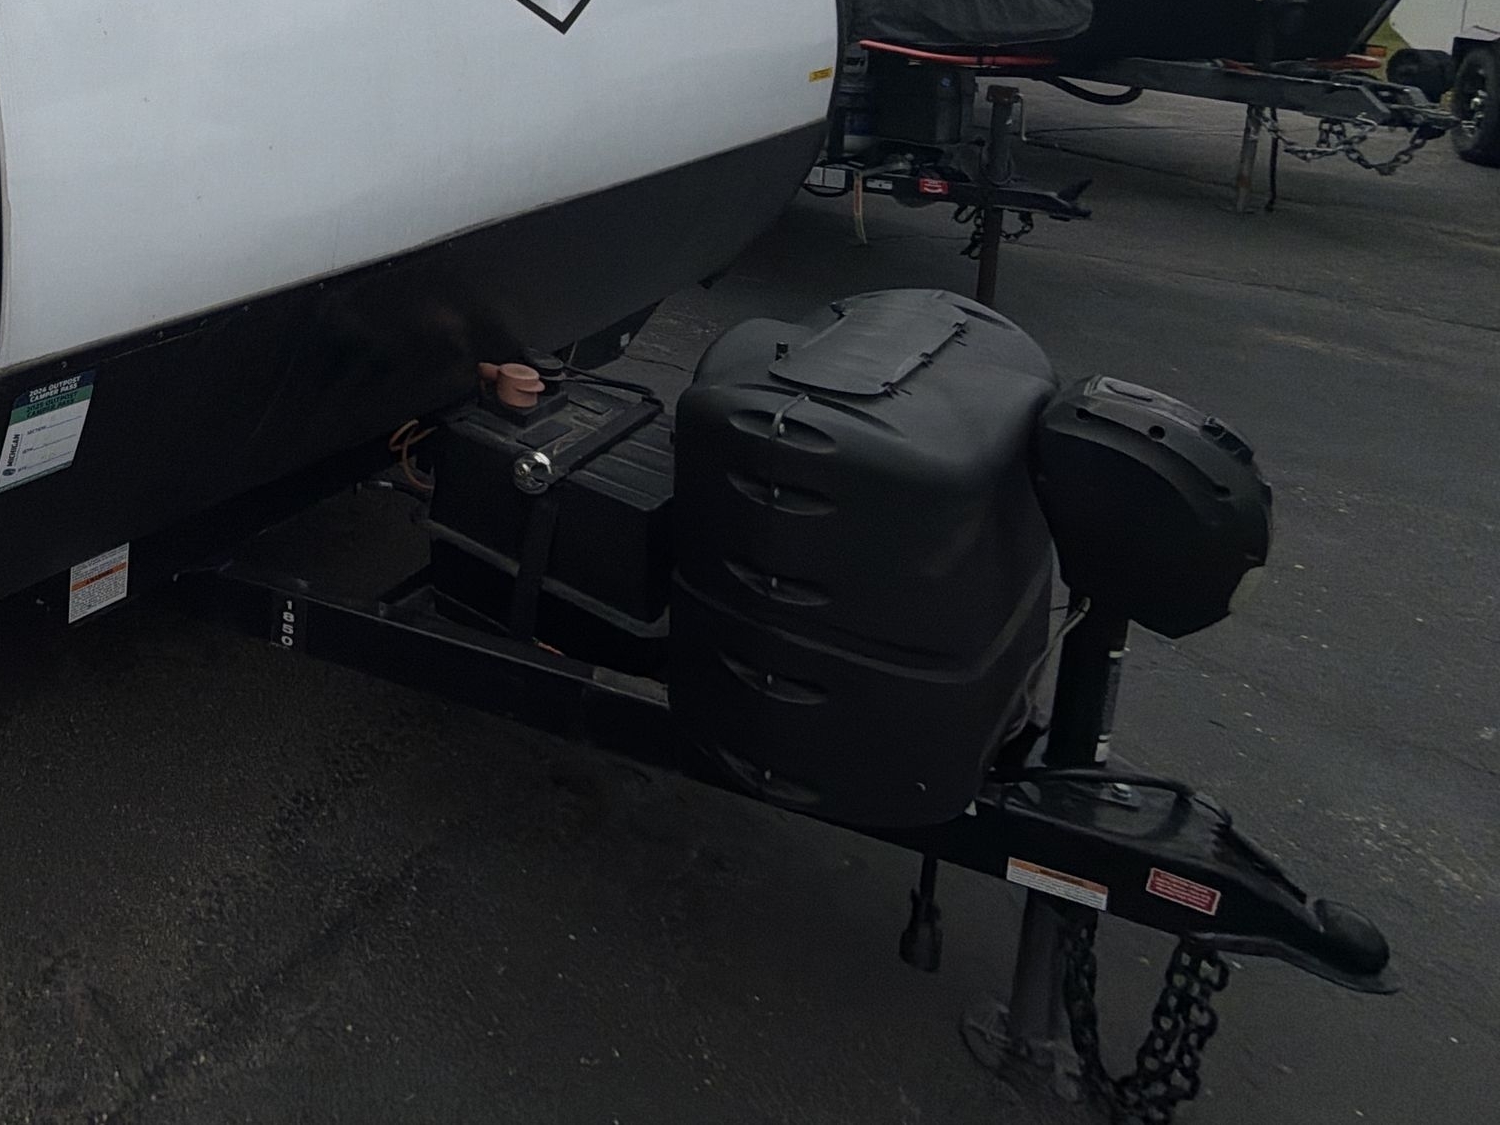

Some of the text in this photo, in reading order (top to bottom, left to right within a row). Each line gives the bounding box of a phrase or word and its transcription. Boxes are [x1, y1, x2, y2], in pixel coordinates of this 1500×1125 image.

[30, 383, 77, 402] CAMPER PASS
[48, 376, 81, 389] OUTPOST
[7, 434, 20, 467] MICHIGAN
[281, 600, 295, 646] 1850
